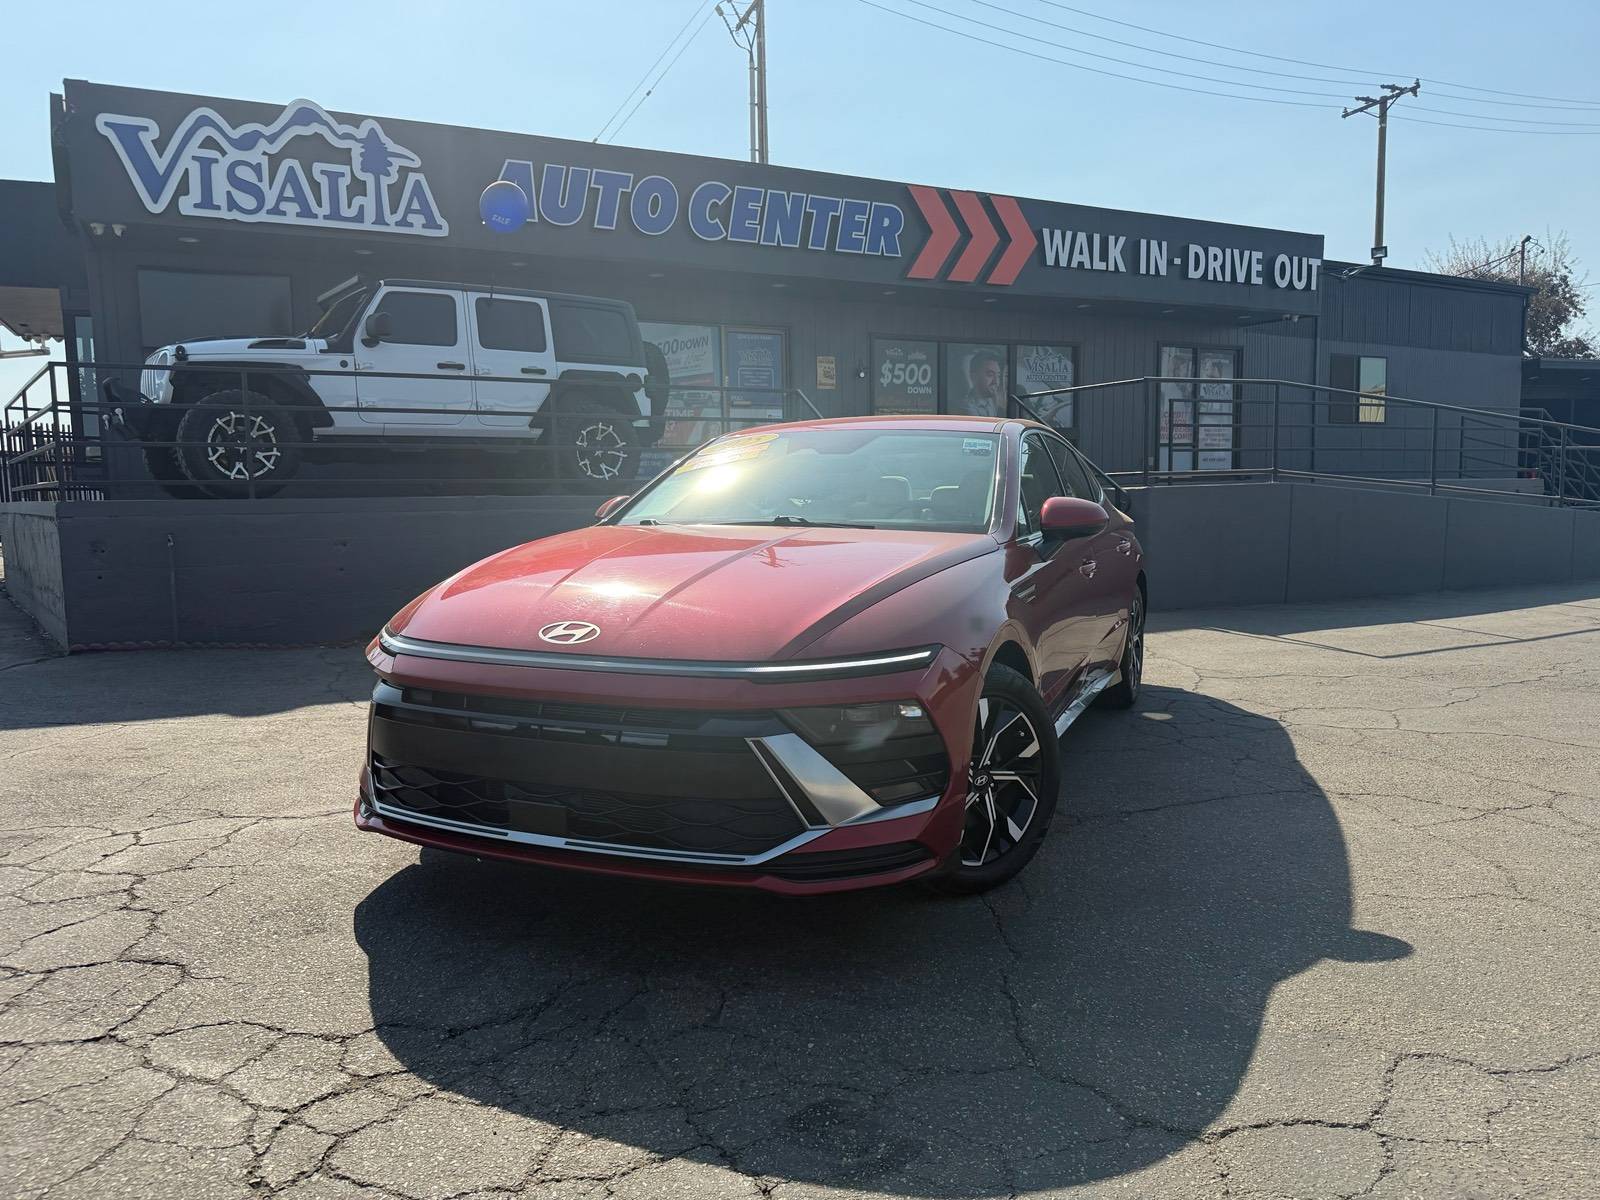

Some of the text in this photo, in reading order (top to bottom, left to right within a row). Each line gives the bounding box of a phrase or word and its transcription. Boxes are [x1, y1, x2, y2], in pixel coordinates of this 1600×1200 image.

[97, 110, 905, 258] VISALIA AUTO CENTER
[1042, 228, 1127, 273] WALK
[1139, 238, 1168, 276] IN
[1188, 243, 1264, 286] DRIVE
[1273, 253, 1323, 291] OUT
[680, 335, 709, 351] DOWN
[880, 360, 932, 387] $500
[907, 386, 932, 395] DOWN
